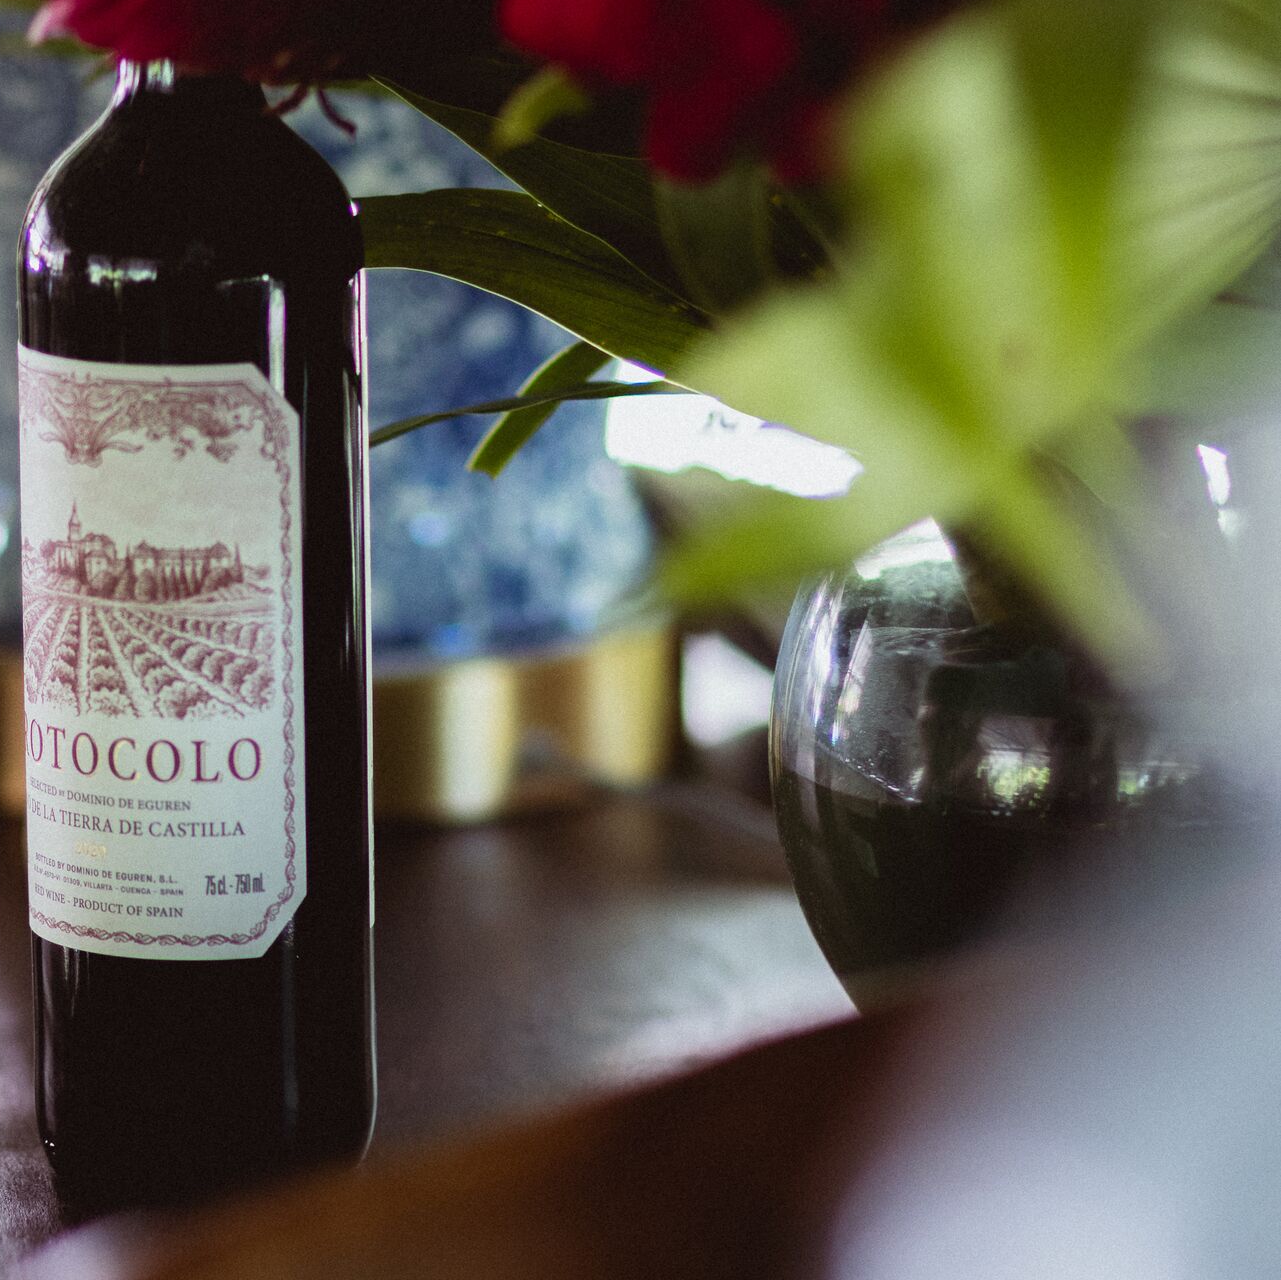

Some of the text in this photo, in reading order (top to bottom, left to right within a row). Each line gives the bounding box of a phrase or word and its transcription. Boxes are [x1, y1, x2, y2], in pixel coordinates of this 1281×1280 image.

[25, 714, 262, 783] OTOCOLO
[66, 790, 115, 807] DOMINIO
[118, 798, 134, 809] DE
[138, 800, 191, 811] EGUREN
[32, 798, 41, 817] DE
[43, 804, 56, 822] LA
[59, 809, 113, 833] TIERRA
[119, 819, 143, 836] DE
[148, 821, 246, 837] CASTILLA
[35, 851, 56, 867] BOTTLED
[57, 860, 65, 870] BY
[66, 863, 99, 877] DOMINIO
[102, 870, 113, 879] DE
[115, 872, 156, 883] EGUREN,
[83, 881, 113, 891] VILLARTA
[120, 885, 151, 896] CUENCA
[159, 888, 184, 896] SPAIN
[204, 874, 217, 895] 75
[235, 873, 251, 895] 750
[34, 883, 44, 897] RED
[45, 888, 66, 904] WINE
[73, 896, 124, 914] PRODUCT
[126, 904, 143, 916] OF
[146, 906, 184, 918] SPAIN
